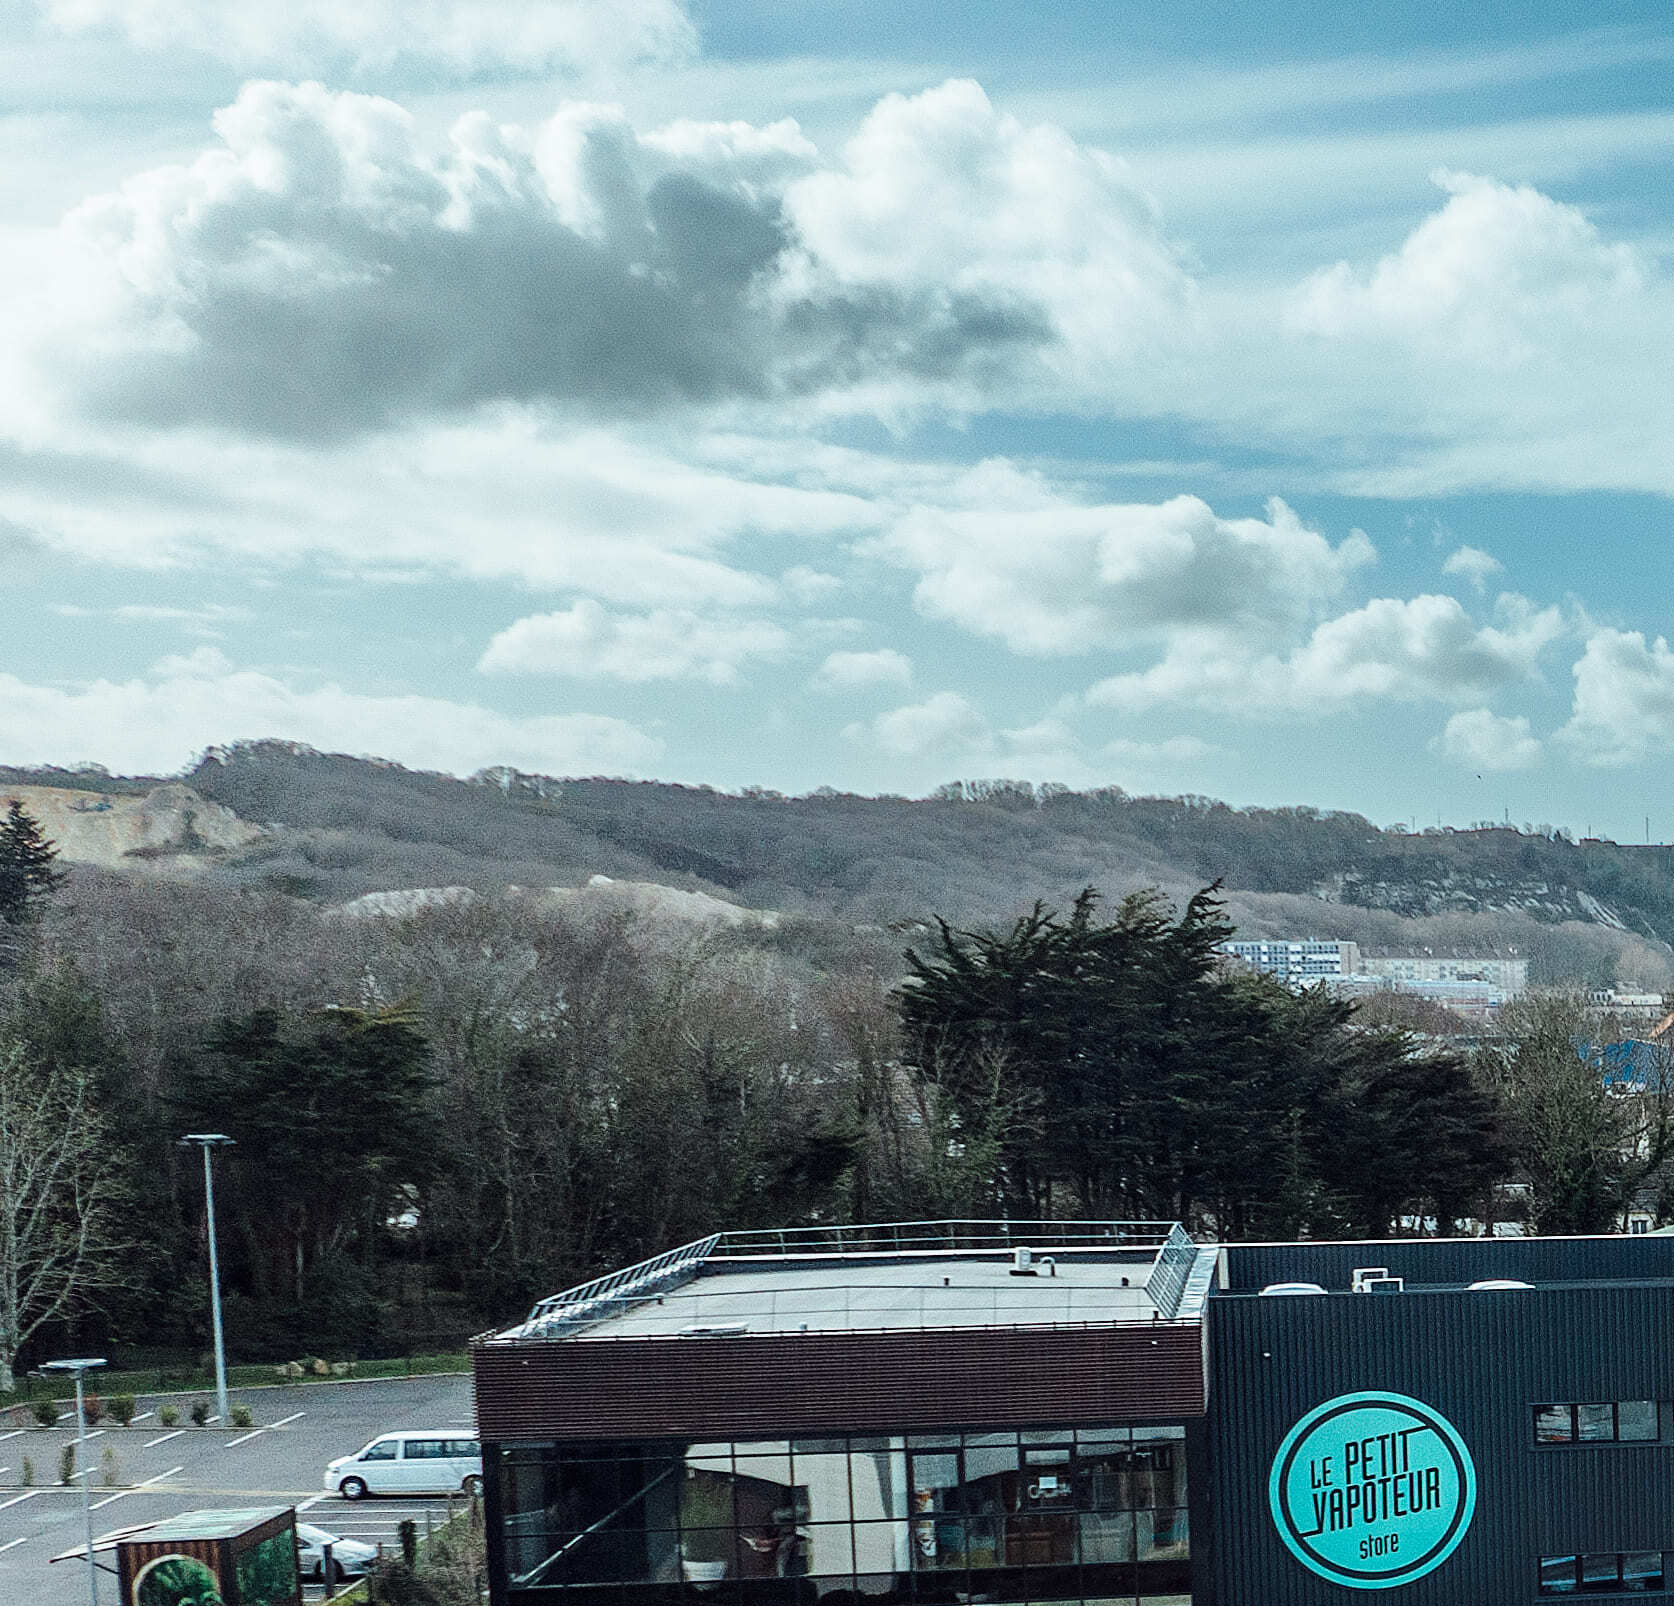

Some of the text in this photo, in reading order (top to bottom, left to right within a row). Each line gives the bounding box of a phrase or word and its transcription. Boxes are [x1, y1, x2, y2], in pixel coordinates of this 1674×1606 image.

[1310, 1427, 1412, 1489] LE PETIT
[1311, 1467, 1440, 1533] VAPOTEUR
[1359, 1533, 1399, 1560] store
